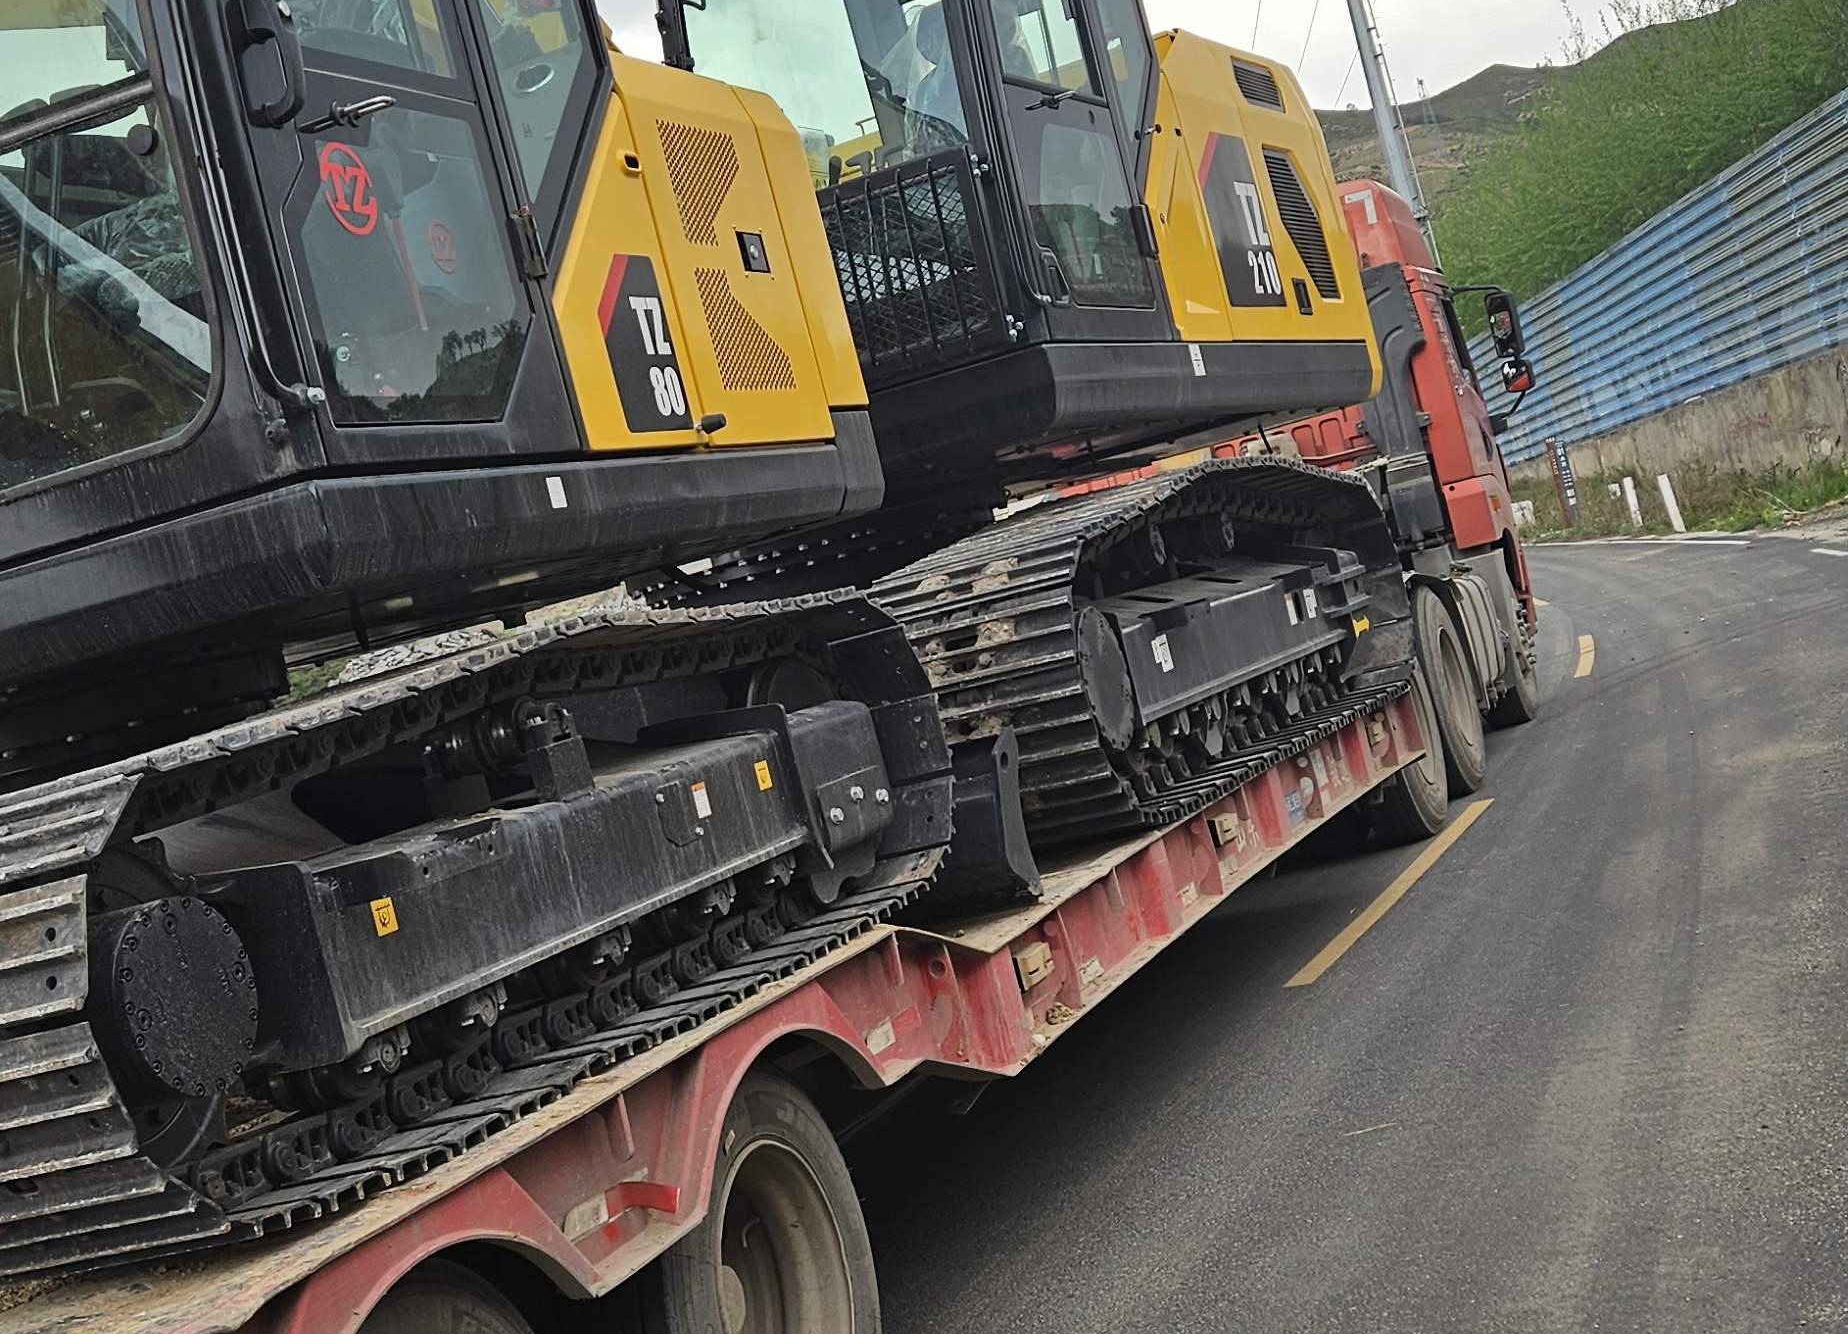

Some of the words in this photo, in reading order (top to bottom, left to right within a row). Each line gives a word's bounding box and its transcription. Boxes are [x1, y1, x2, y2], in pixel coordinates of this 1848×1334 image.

[320, 158, 377, 217] TZ
[1233, 181, 1271, 246] TZ
[1247, 250, 1281, 295] 210
[628, 296, 672, 355] TZ
[649, 366, 686, 417] 80
